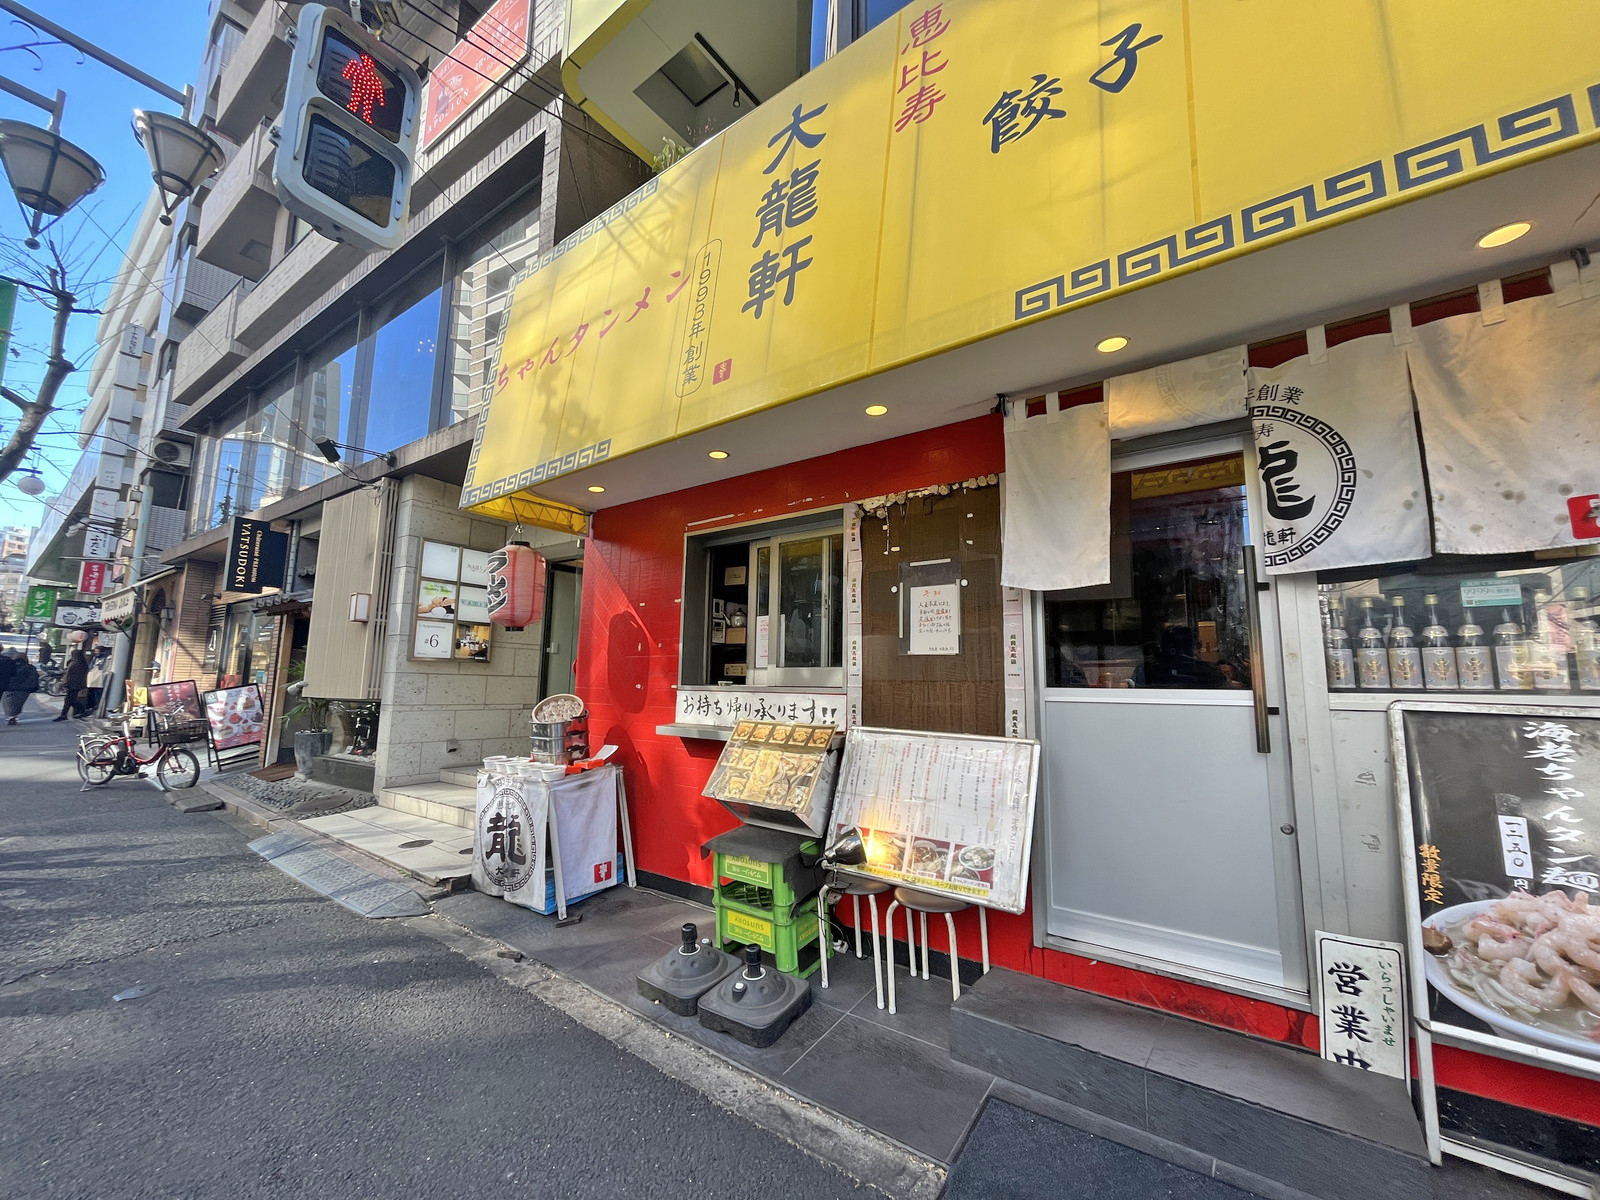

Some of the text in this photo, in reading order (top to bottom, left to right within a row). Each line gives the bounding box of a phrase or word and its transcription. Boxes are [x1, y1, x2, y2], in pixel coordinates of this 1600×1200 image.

[895, 2, 952, 133] 恵比寿
[981, 22, 1164, 154] 餃子
[741, 102, 829, 320] 大龍軒
[495, 270, 692, 396] ちゃんタンメン
[681, 251, 712, 387] 1993年創業
[234, 523, 252, 588] YATSUDOKI
[485, 812, 527, 866] 龍
[1418, 843, 1444, 905] 数量限定
[734, 915, 765, 931] SUNTORY
